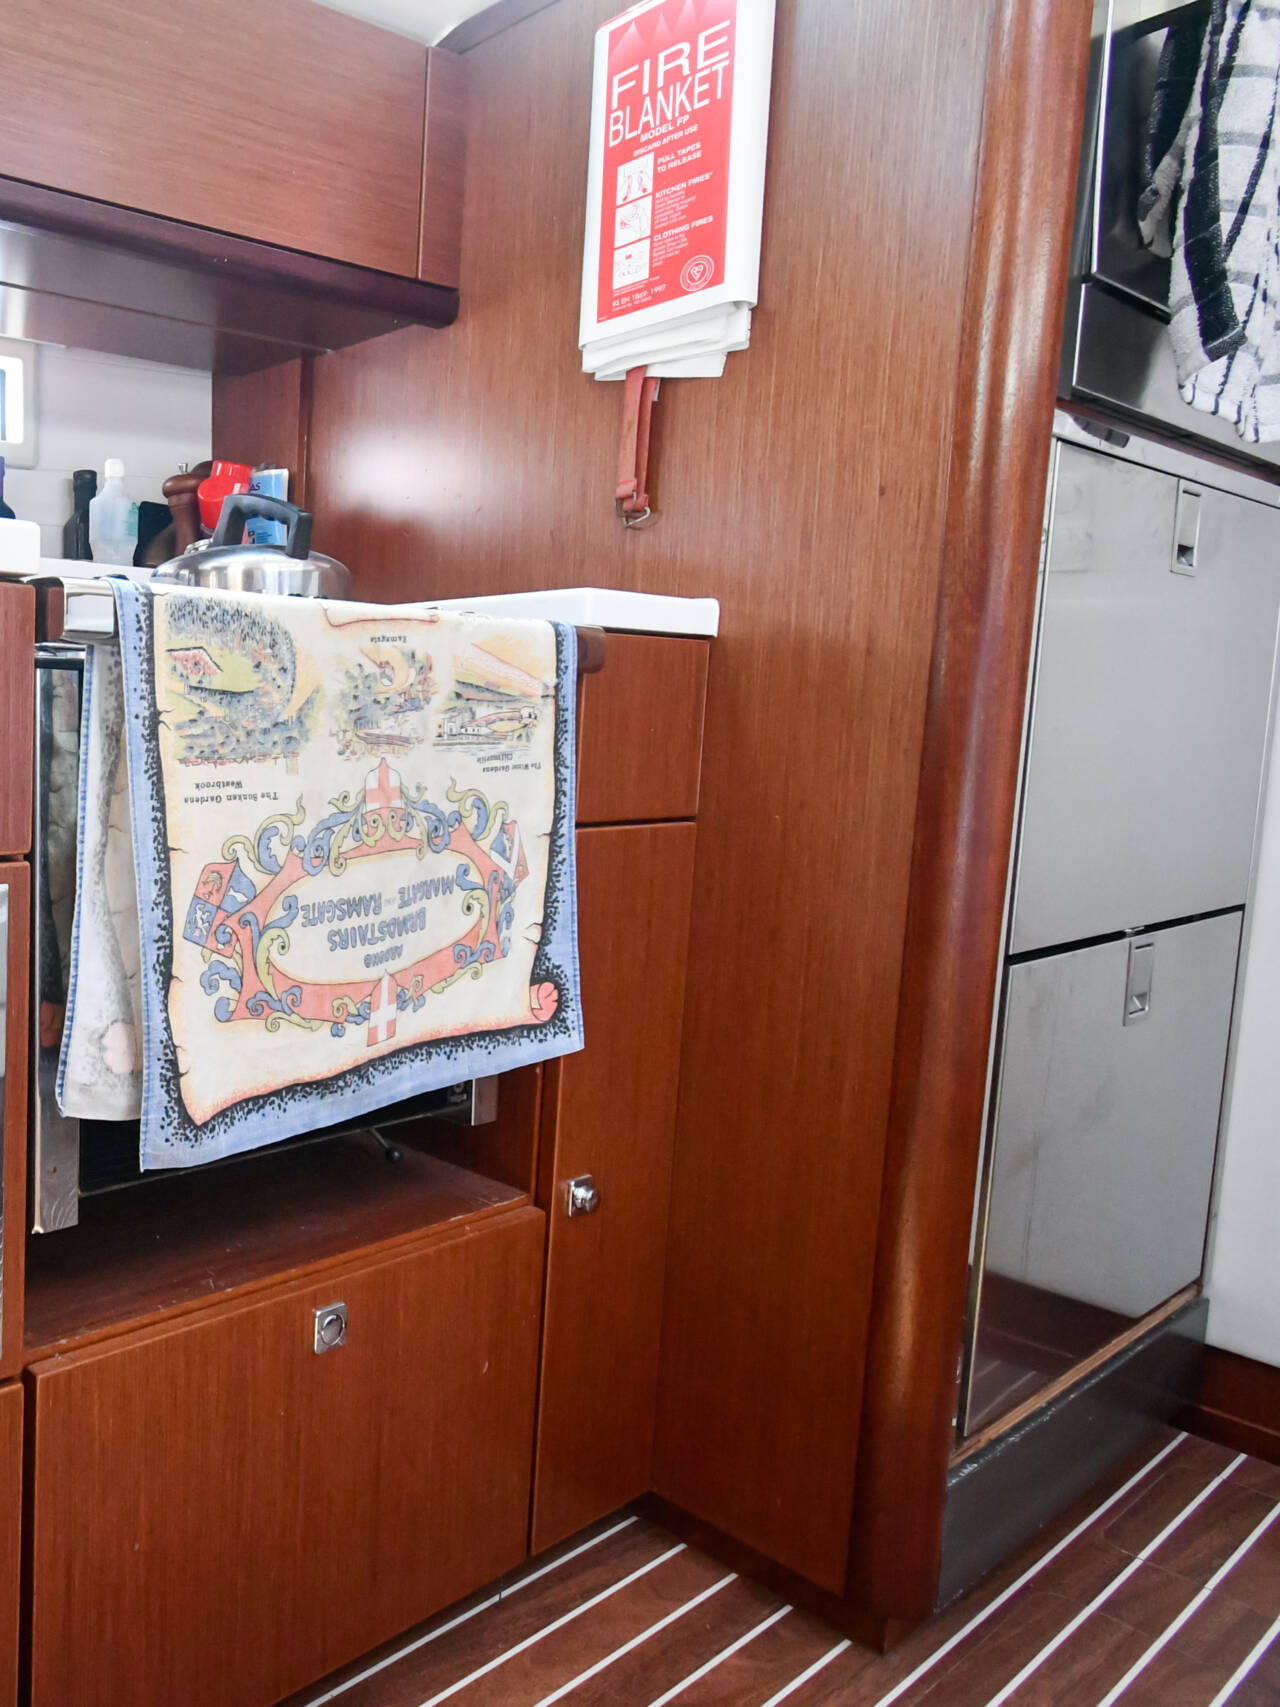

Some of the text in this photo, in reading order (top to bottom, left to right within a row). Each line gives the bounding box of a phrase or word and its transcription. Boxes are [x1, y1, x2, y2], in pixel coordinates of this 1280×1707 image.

[611, 19, 730, 110] FIRE
[608, 59, 730, 148] BLANKET
[633, 124, 698, 157] DISCARD AFTER USE
[640, 114, 690, 143] MODEL FP
[657, 142, 701, 165] PULL TAPES
[657, 150, 702, 174] TO RELEASE
[655, 181, 687, 199] KITCHEN
[653, 215, 714, 242] CLOTHING FIRES
[482, 765, 510, 773] Gardens
[184, 791, 279, 805] The Sunken Gardens
[194, 780, 243, 791] Westbrook
[398, 875, 455, 909] MARGATE
[300, 892, 382, 928] RAMSGATE
